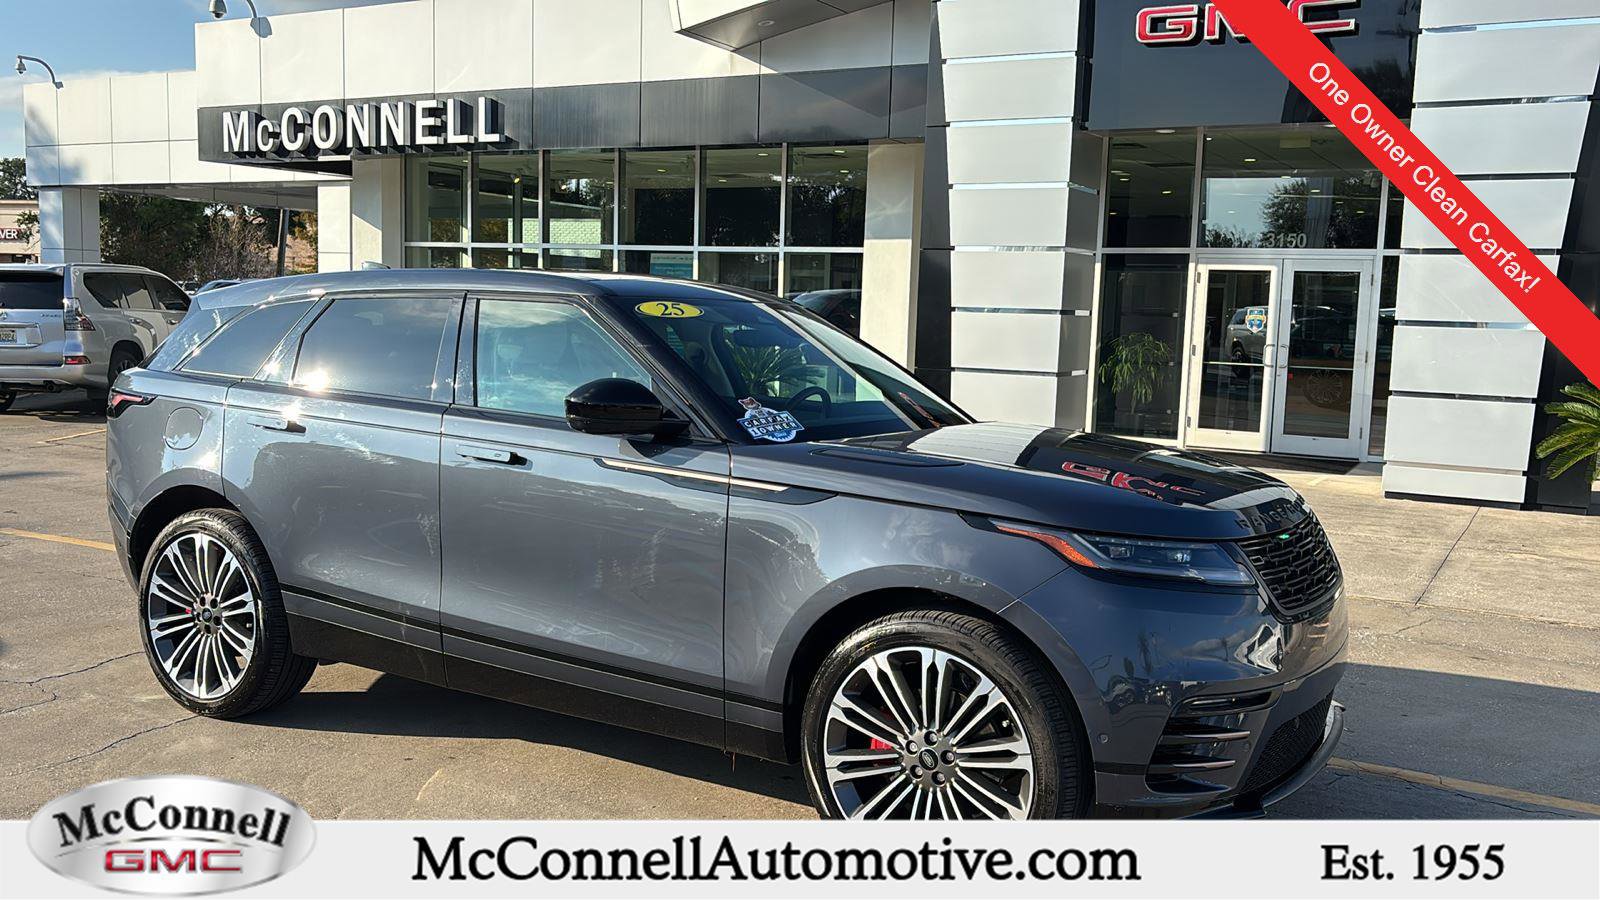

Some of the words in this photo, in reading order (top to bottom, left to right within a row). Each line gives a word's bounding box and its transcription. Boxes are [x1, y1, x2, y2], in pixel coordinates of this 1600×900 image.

[222, 96, 501, 153] McCONNELL
[1266, 232, 1307, 248] 3150
[655, 302, 685, 317] 25
[744, 414, 794, 428] CARFAX
[759, 421, 798, 434] OWNER
